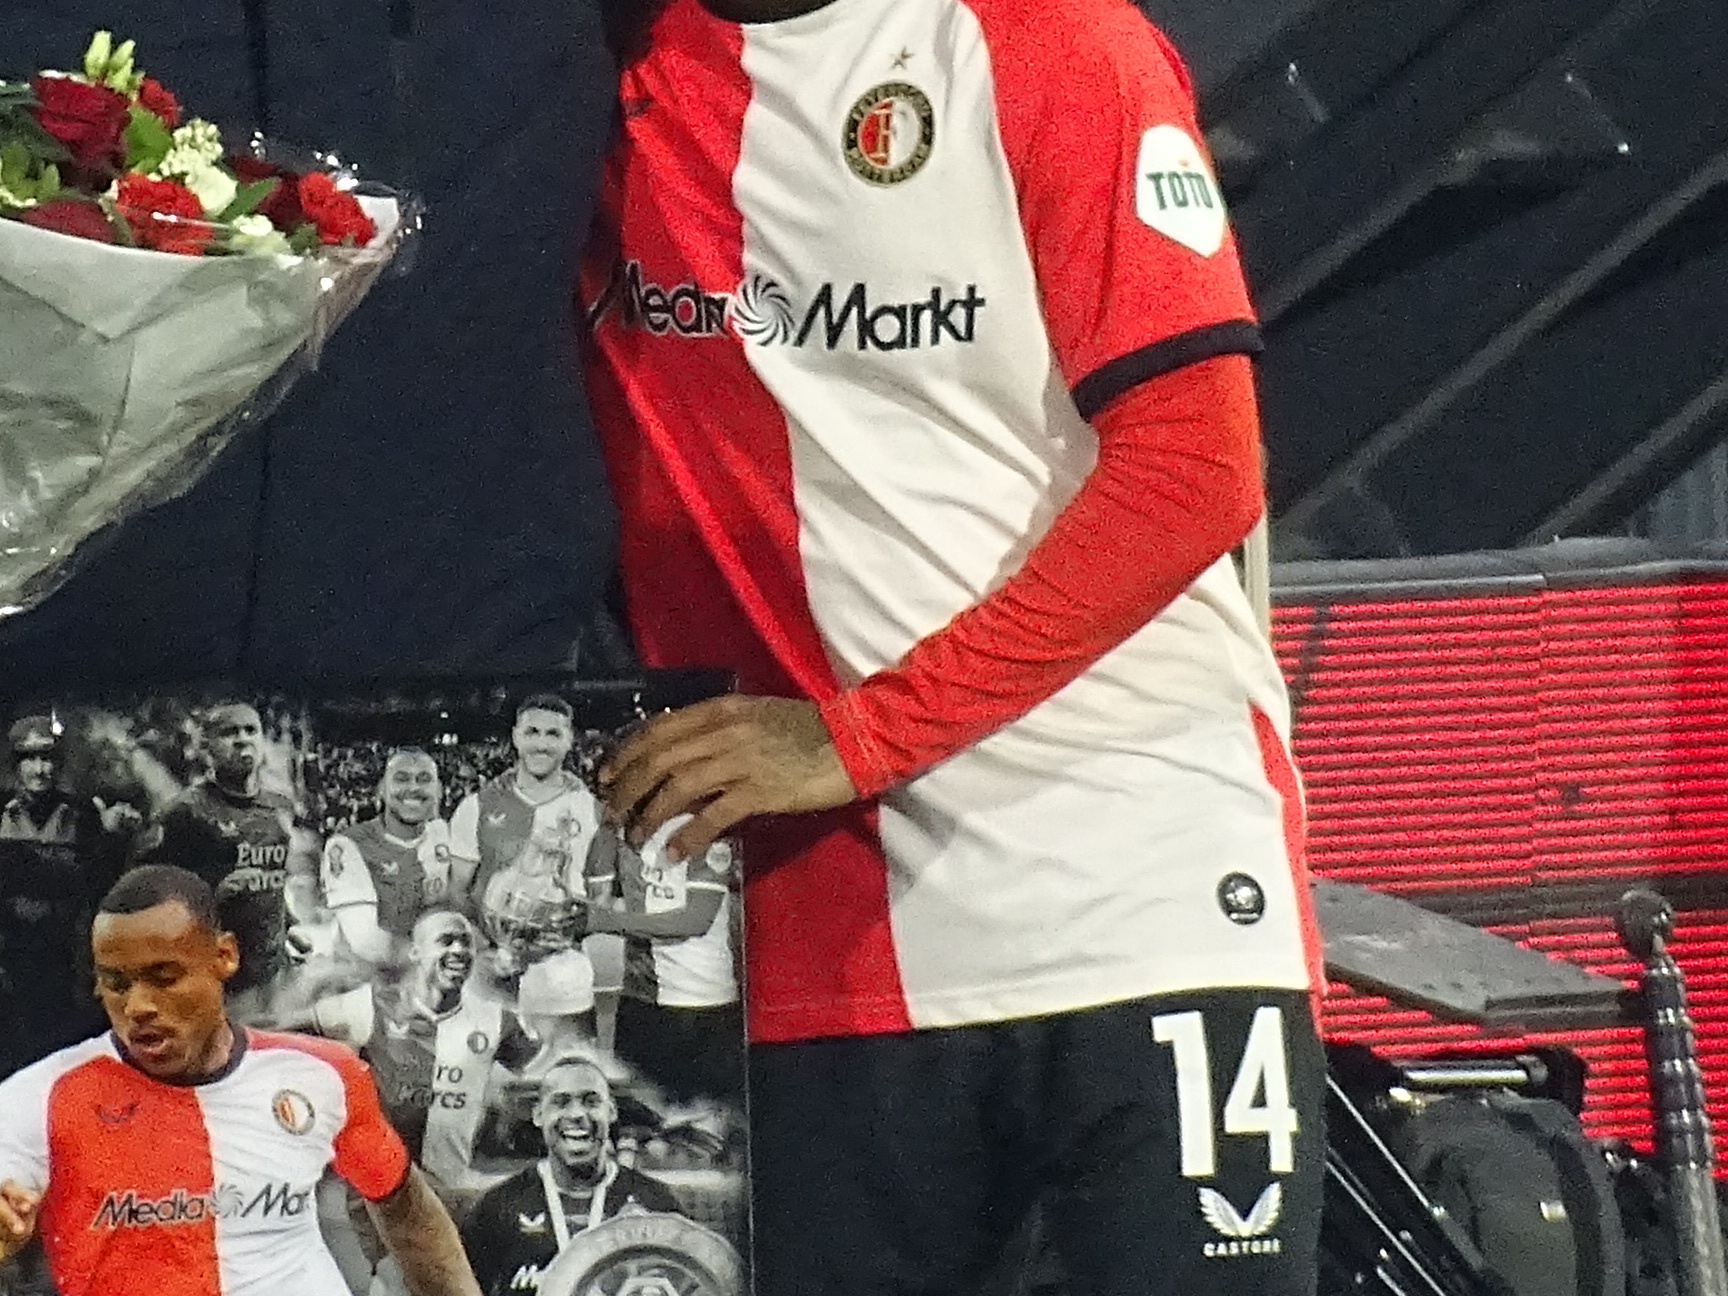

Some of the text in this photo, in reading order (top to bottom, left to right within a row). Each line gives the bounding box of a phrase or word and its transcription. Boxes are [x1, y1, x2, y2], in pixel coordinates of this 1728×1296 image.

[792, 281, 987, 352] Markt
[1151, 1005, 1300, 1178] 14
[92, 1190, 206, 1228] Media
